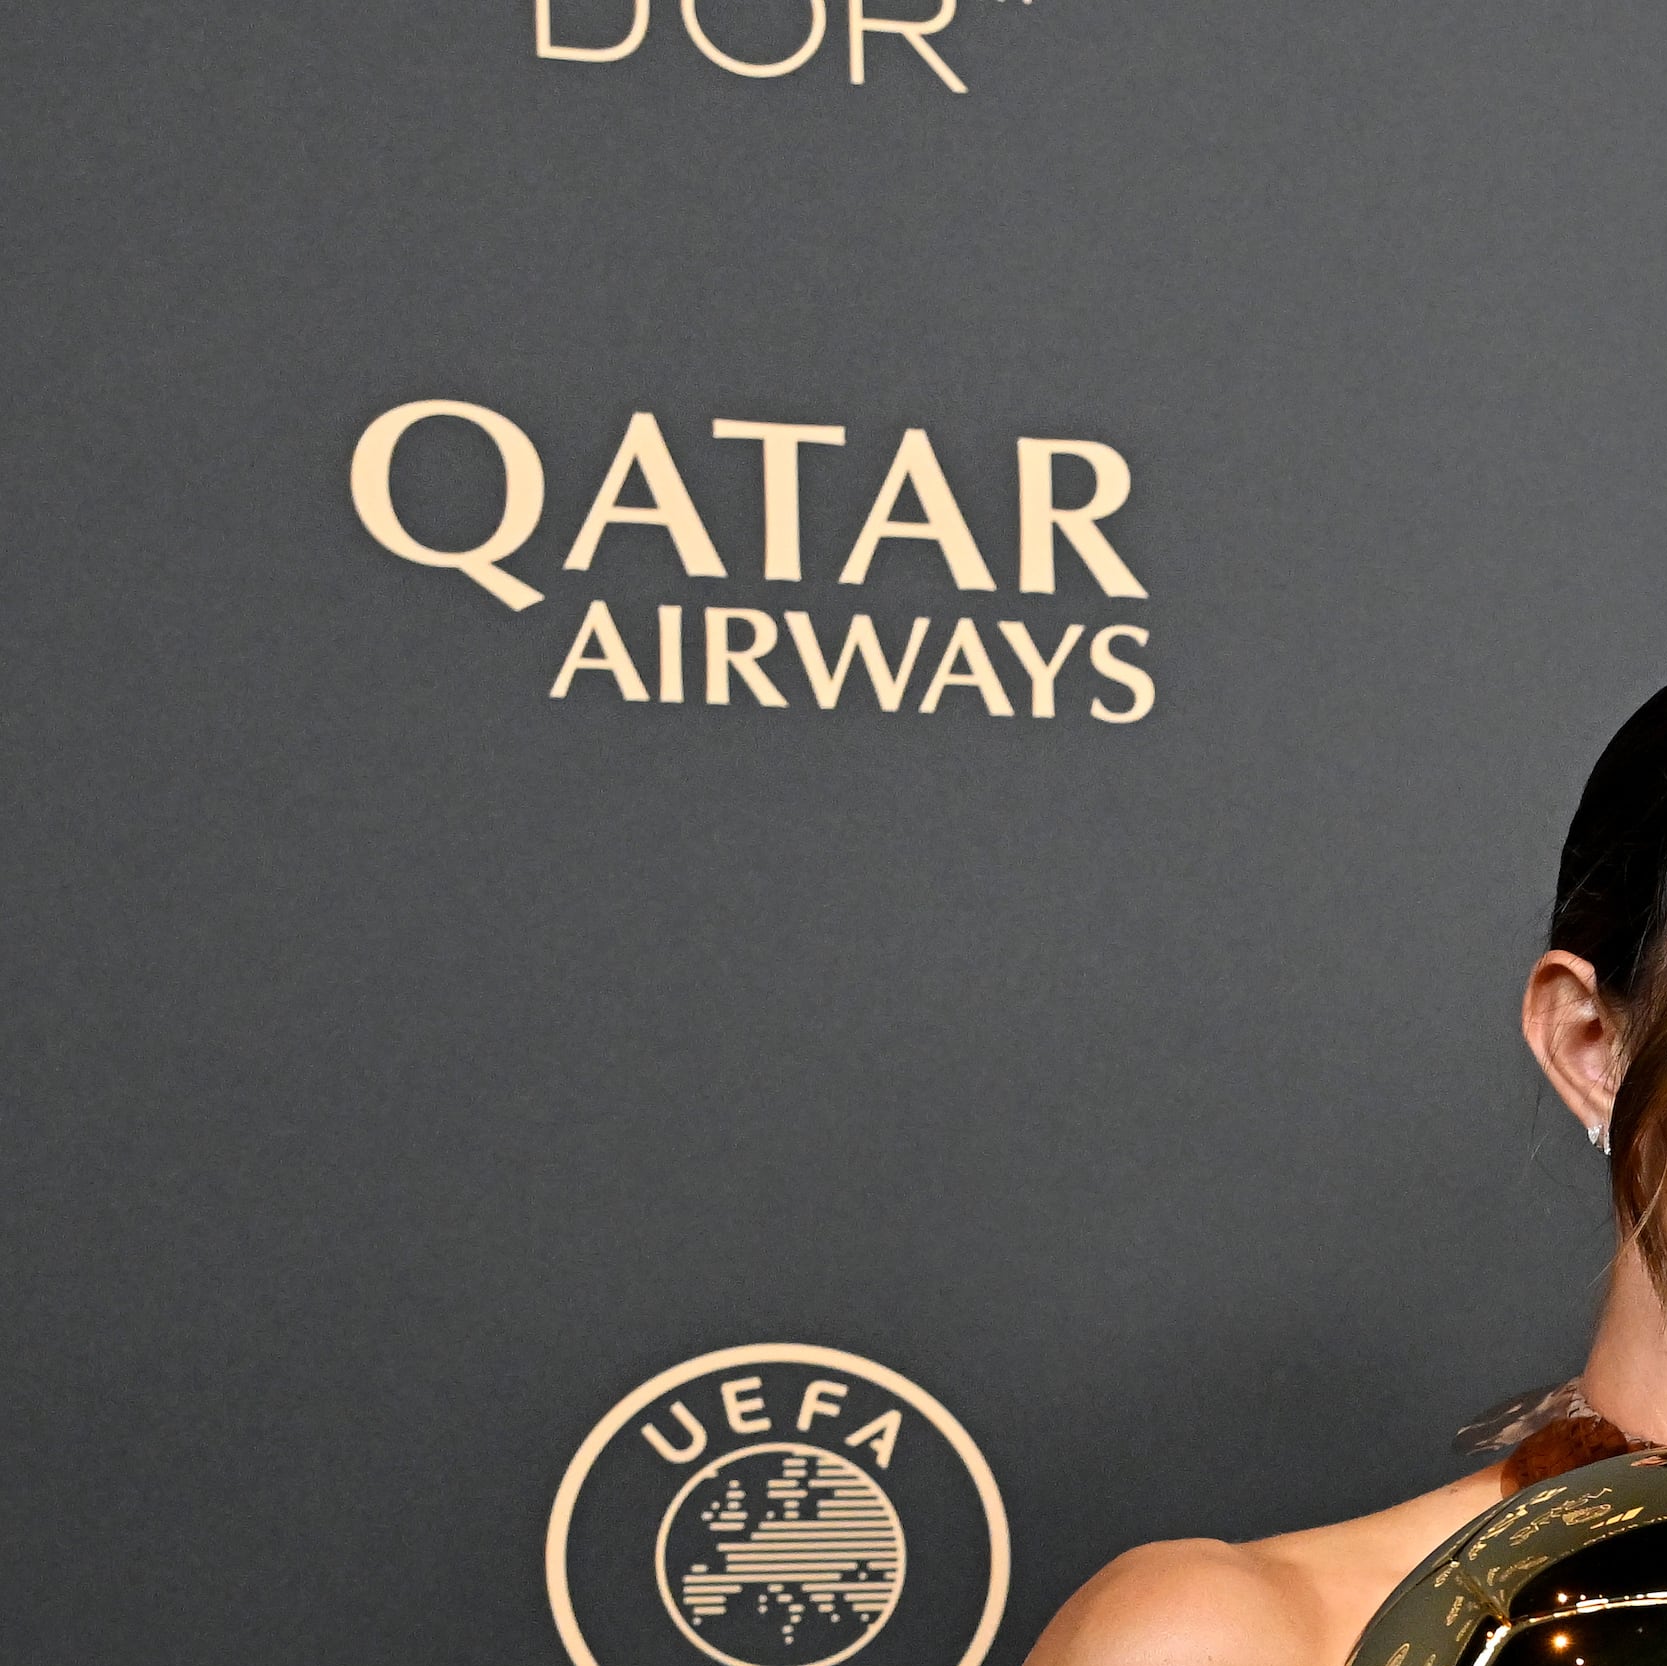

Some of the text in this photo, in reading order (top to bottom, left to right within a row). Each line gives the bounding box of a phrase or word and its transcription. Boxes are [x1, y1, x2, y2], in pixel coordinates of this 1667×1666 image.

[350, 399, 1149, 612] QATAR
[550, 599, 1157, 724] AIRWAYS
[640, 1375, 904, 1469] UEFA
